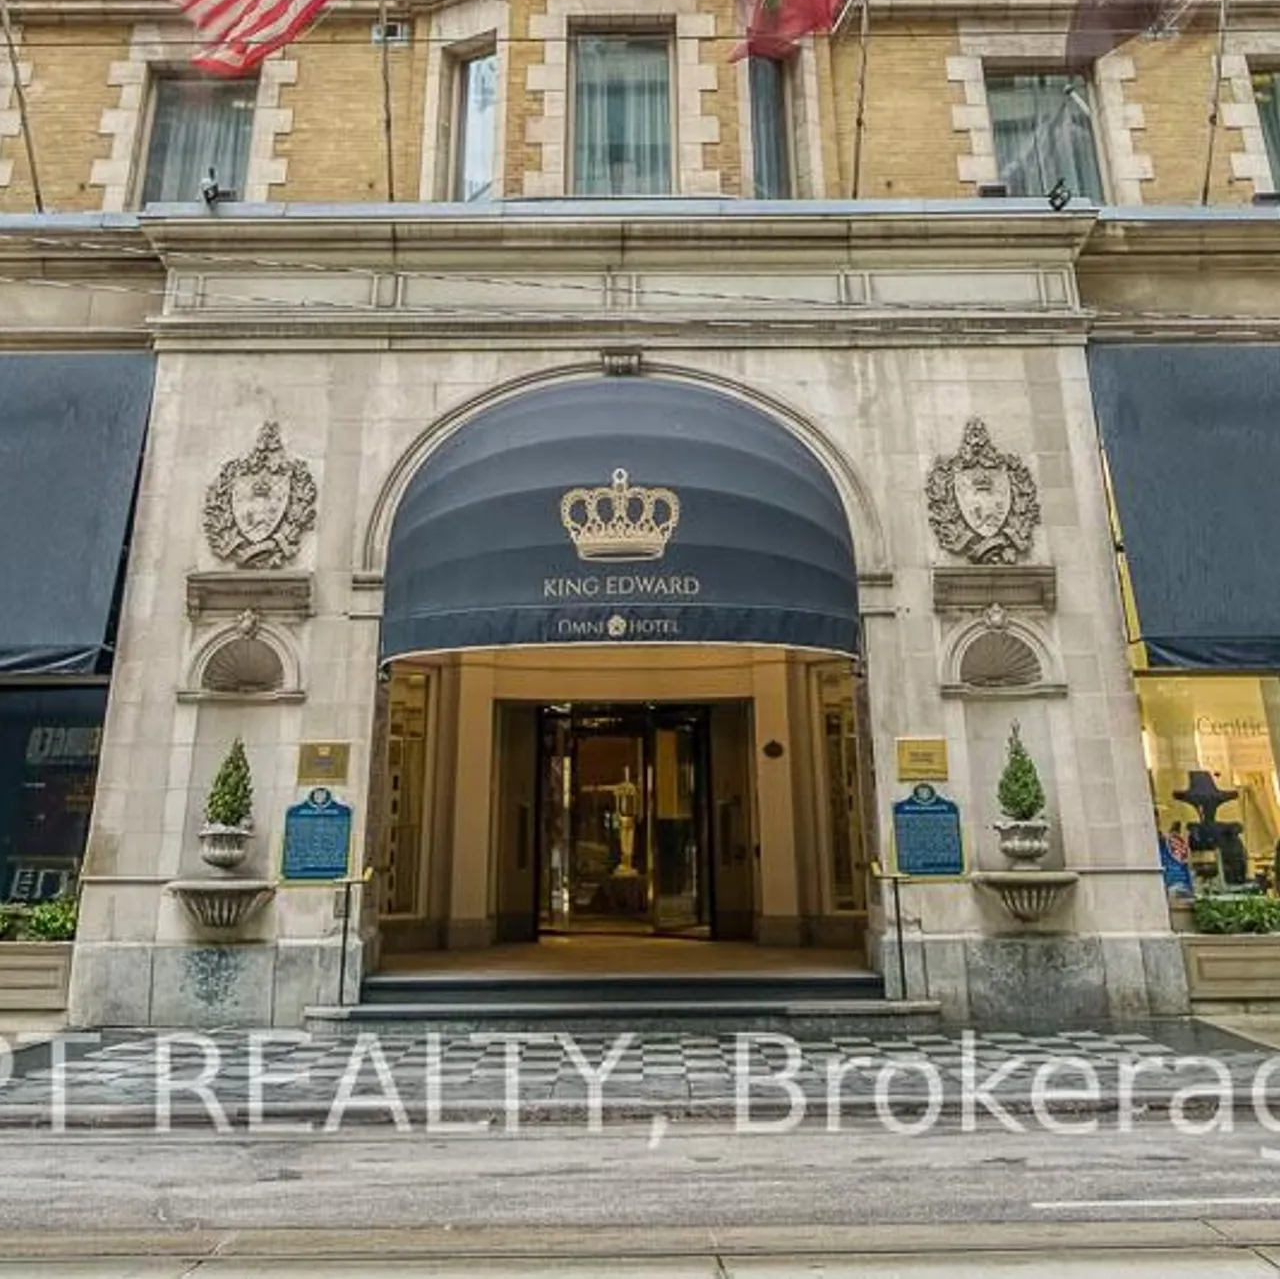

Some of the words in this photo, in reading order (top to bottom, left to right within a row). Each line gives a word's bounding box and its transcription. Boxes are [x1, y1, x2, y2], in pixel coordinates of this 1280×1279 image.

[543, 577, 600, 598] KING
[605, 575, 701, 596] EDWARD
[558, 619, 604, 635] OMNI
[630, 619, 681, 634] HOTEL
